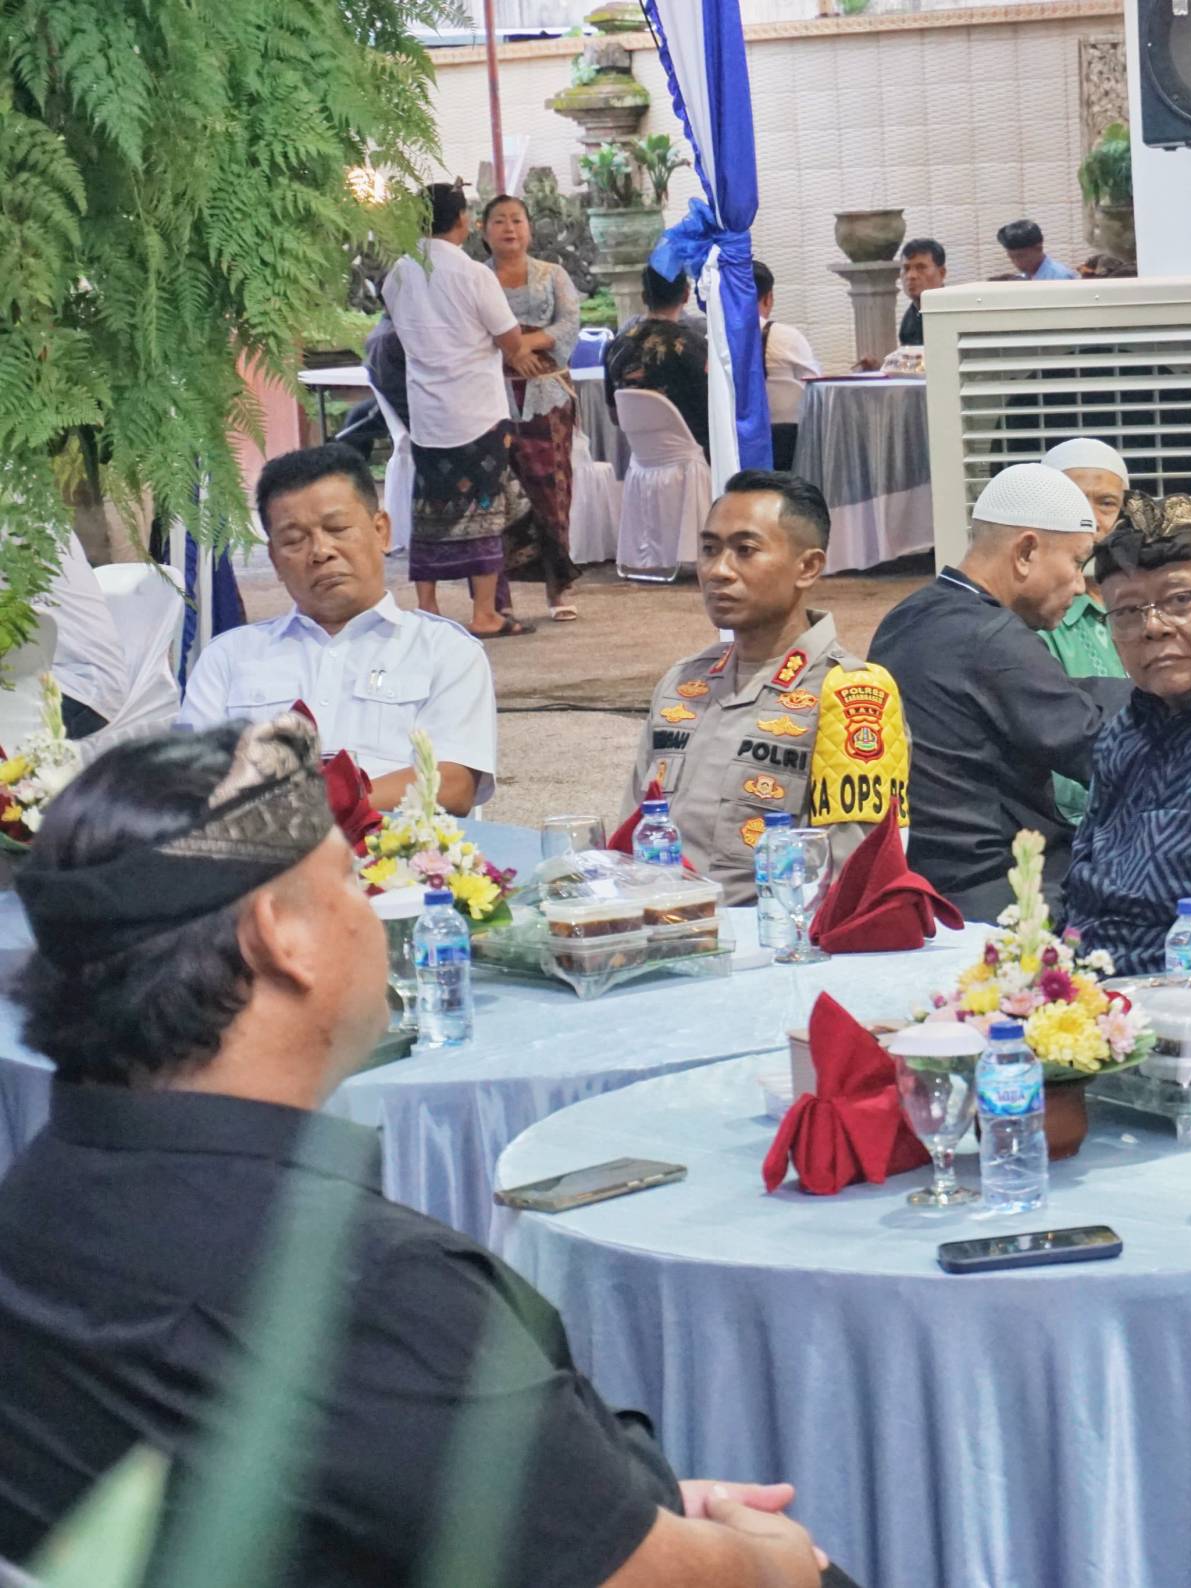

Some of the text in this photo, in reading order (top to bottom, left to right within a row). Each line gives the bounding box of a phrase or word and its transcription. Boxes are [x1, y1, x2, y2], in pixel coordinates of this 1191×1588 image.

[841, 687, 885, 699] POLRES
[848, 707, 880, 716] BALI
[737, 739, 807, 770] POLRI
[840, 774, 883, 814] OPS
